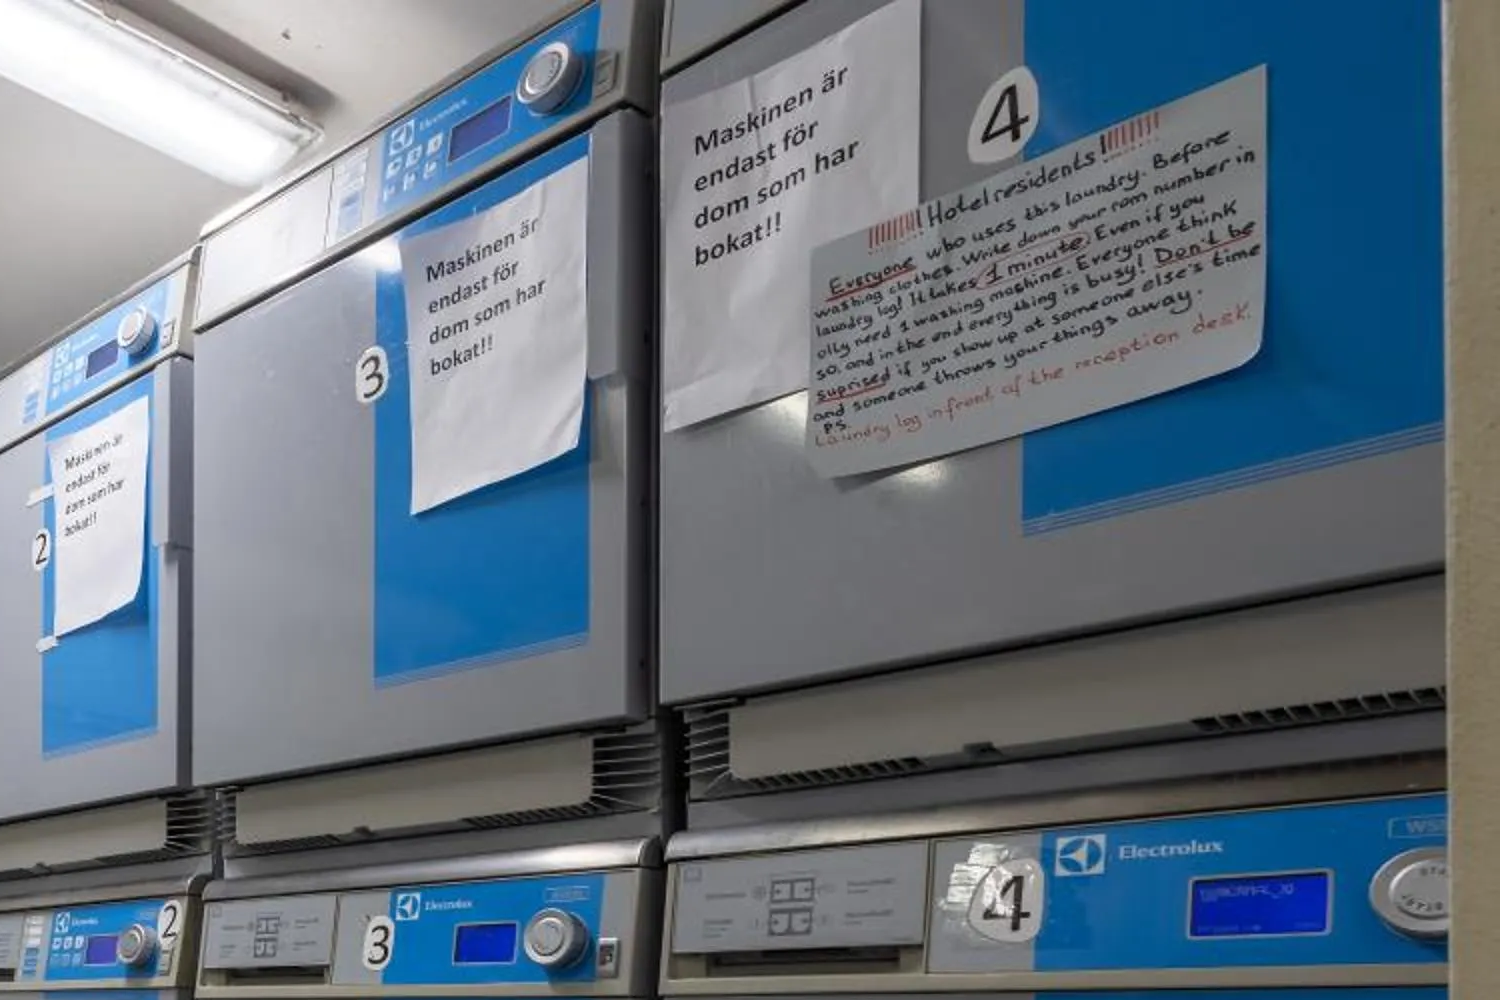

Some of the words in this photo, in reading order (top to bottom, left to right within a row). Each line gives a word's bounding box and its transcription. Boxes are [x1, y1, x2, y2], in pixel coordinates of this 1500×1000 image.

[695, 86, 812, 156] Maskinen
[821, 65, 849, 94] är
[980, 84, 1029, 145] 4
[695, 143, 776, 192] endast
[783, 119, 819, 154] för
[695, 194, 749, 230] dom
[757, 168, 806, 205] som
[815, 138, 859, 175] har
[928, 188, 988, 227] Hotel
[988, 152, 1096, 204] residents
[695, 212, 782, 267] bokat!!
[814, 291, 883, 319] washing
[961, 242, 1012, 266] Write
[1018, 225, 1061, 248] down
[1068, 207, 1107, 230] your
[1153, 158, 1231, 195] number
[1236, 145, 1255, 164] in
[829, 256, 916, 298] Everyone
[926, 236, 966, 260] who
[972, 218, 1016, 242] uses
[1024, 201, 1060, 221] this
[1152, 130, 1230, 171] Before
[426, 232, 515, 282] Maskinen
[519, 218, 539, 240] är
[816, 316, 873, 337] laundry
[929, 278, 977, 300] takes
[984, 261, 1004, 285] 1
[1094, 220, 1140, 241] Even
[1146, 203, 1164, 223] if
[1169, 194, 1205, 220] you
[855, 325, 891, 347] need
[900, 320, 910, 333] 1
[913, 298, 985, 327] washing
[1076, 228, 1170, 277] Everyone
[1177, 199, 1237, 232] think
[428, 276, 487, 314] endast
[492, 261, 519, 286] för
[428, 317, 469, 345] dom
[474, 300, 510, 327] som
[515, 279, 546, 307] har
[845, 352, 875, 370] and
[879, 349, 894, 360] in
[896, 338, 926, 354] the
[1062, 283, 1080, 295] is
[1226, 221, 1256, 241] be
[896, 360, 911, 377] if
[922, 356, 947, 374] you
[953, 339, 993, 358] show
[997, 331, 1018, 344] up
[1024, 316, 1045, 334] at
[1052, 288, 1134, 325] someone
[1142, 262, 1204, 292] else's
[1212, 245, 1260, 267] time
[360, 355, 384, 399] 3
[430, 335, 493, 377] bokat!!
[812, 403, 845, 422] and
[852, 381, 927, 412] someone
[933, 358, 996, 384] throws
[1004, 341, 1048, 369] your
[1052, 315, 1118, 343] things
[895, 414, 922, 433] log
[1001, 375, 1021, 397] of
[1029, 367, 1064, 385] the
[1075, 331, 1180, 370] reception
[35, 533, 48, 564] 2
[1118, 839, 1224, 861] Electrolux
[162, 905, 178, 938] 2
[983, 876, 1031, 931] 4
[368, 925, 389, 965] 3
